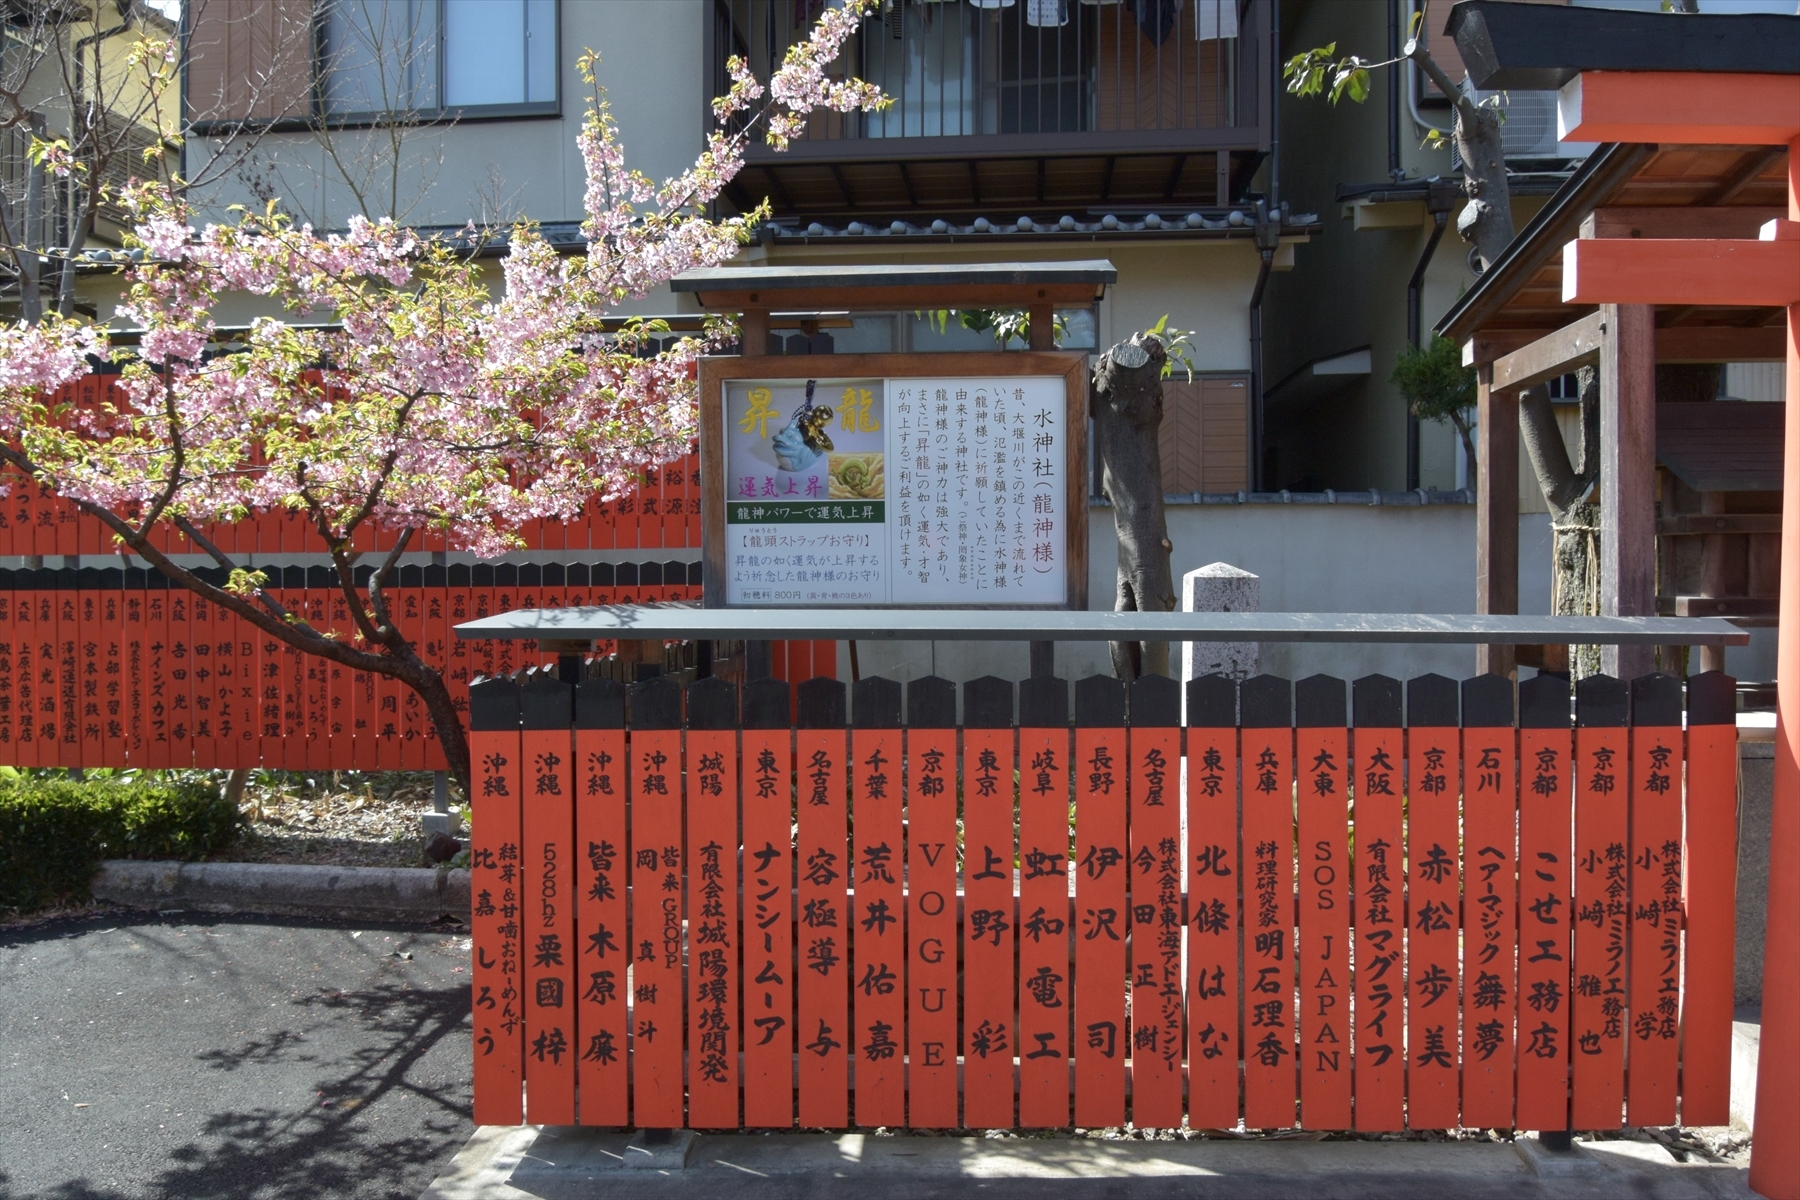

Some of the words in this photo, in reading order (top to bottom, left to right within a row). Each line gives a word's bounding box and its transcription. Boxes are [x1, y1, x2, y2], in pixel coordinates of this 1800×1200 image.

[738, 386, 780, 440] 昇
[836, 386, 881, 434] 龍
[738, 475, 823, 498] 運気上昇
[898, 388, 913, 576] が向上するご利益を頂けます。
[935, 387, 949, 583] 龍神様のご神力は強大であり、
[993, 387, 1007, 589] いた頃、氾濫を鎮める為に水神様
[1012, 387, 1026, 588] 昔、大堰川がこの近くまで流れて
[1032, 408, 1055, 574] 水神社（龍神様）
[736, 505, 875, 520] 龍神パワーで運気上昇
[734, 554, 880, 567] 昇龍の如く運気が上昇する
[742, 534, 869, 548] 【龍頭ストラップお守り】
[734, 570, 880, 583] よう祈念した龍神様のお守り
[774, 590, 801, 600] 800円
[18, 599, 31, 622] 大阪
[39, 598, 51, 622] 兵庫
[61, 598, 75, 622] 大阪
[83, 597, 94, 622] 東京
[105, 597, 117, 622] 兵庫
[127, 598, 141, 622] 静岡
[149, 598, 162, 622] 石川
[172, 597, 186, 622] 大阪
[194, 597, 207, 621] 福岡
[310, 597, 324, 620] 沖縄
[333, 597, 347, 620] 沖縄
[405, 595, 418, 619] 愛知
[429, 597, 442, 619] 大阪
[453, 594, 466, 619] 京都
[17, 642, 33, 743] 上原広告代理店
[149, 641, 167, 743] ナインズカフェ
[216, 641, 233, 738] 横山かよ子
[241, 641, 253, 741] Bixie
[483, 753, 511, 798] 沖縄
[535, 752, 563, 797] 沖縄
[587, 751, 615, 796] 沖縄
[643, 751, 669, 796] 沖縄
[697, 753, 726, 797] 城陽
[756, 749, 780, 799] 東京
[809, 750, 833, 807] 名古屋
[865, 749, 889, 800] 千葉
[918, 748, 946, 797] 京都
[976, 749, 1001, 798] 東京
[1031, 749, 1059, 796] 岐阜
[1088, 746, 1116, 795] 長野
[1144, 748, 1168, 808] 名古屋
[1201, 747, 1225, 798] 東京
[1256, 747, 1280, 795] 兵庫
[1312, 749, 1339, 798] 大東
[1366, 747, 1395, 797] 大阪
[1421, 747, 1447, 795] 京都
[1477, 747, 1502, 792] 石川
[1531, 747, 1559, 798] 京都
[1590, 747, 1616, 794] 京都
[1646, 745, 1673, 795] 京都
[1312, 841, 1336, 911] SOS
[471, 848, 499, 1056] 比嘉しろう
[753, 842, 787, 1046] ナンシームーア
[1024, 847, 1068, 1061] 虹和電工
[1158, 838, 1182, 1073] 株式会社東海アドエージェンシー
[1364, 838, 1401, 1068] 有限会社マグライフ
[1472, 846, 1508, 1062] ヘアーマジック舞夢
[1525, 851, 1564, 1060] こせ工務店
[1602, 843, 1627, 1040] 株式会社ミラノ工務店
[1656, 841, 1683, 1043] 株式会社ミラノ工務店
[1315, 935, 1341, 1073] JAPAN
